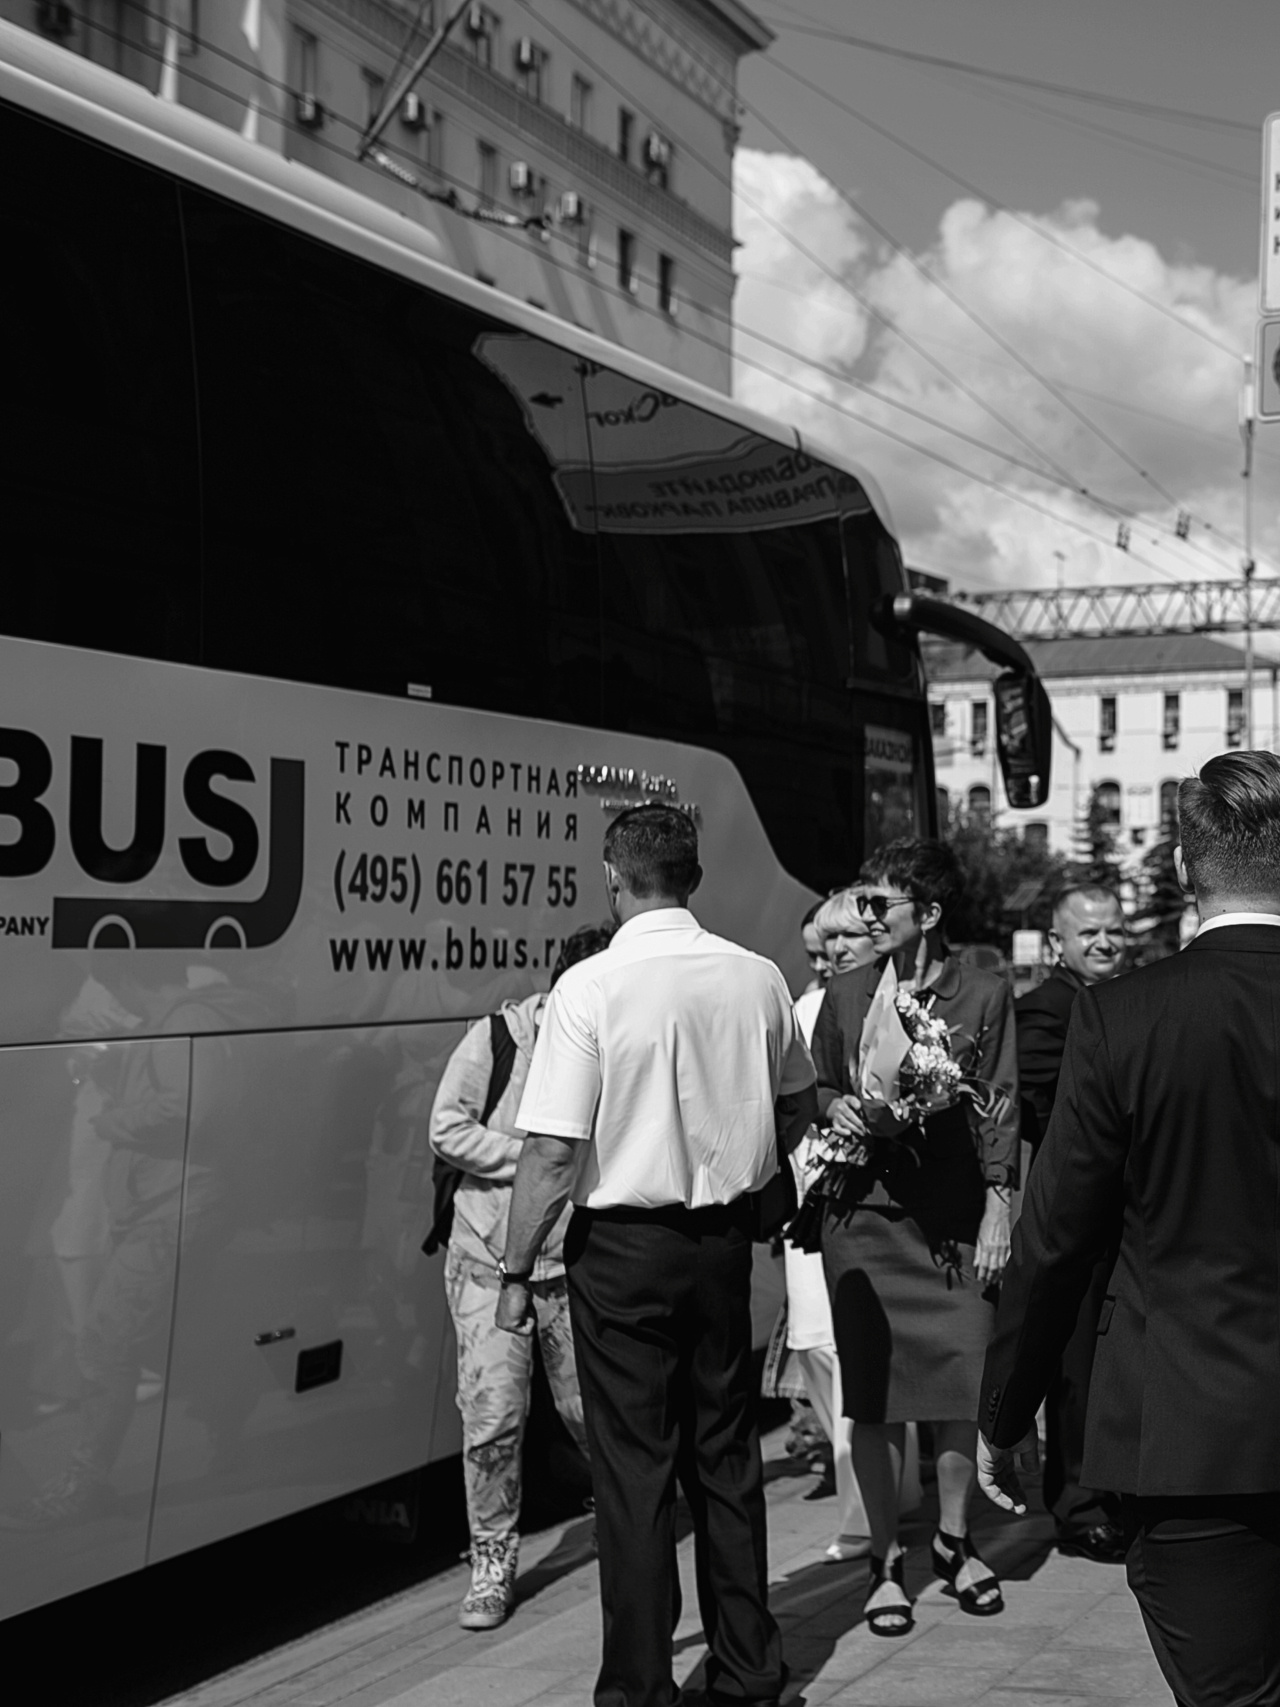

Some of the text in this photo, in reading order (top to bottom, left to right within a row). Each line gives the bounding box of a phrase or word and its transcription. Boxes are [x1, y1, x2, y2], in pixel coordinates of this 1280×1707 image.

[335, 740, 578, 798] ТРАНСПОРТНАЯ
[336, 791, 577, 841] КОМПАНИЯ
[334, 848, 577, 914] (495) 661 57 55
